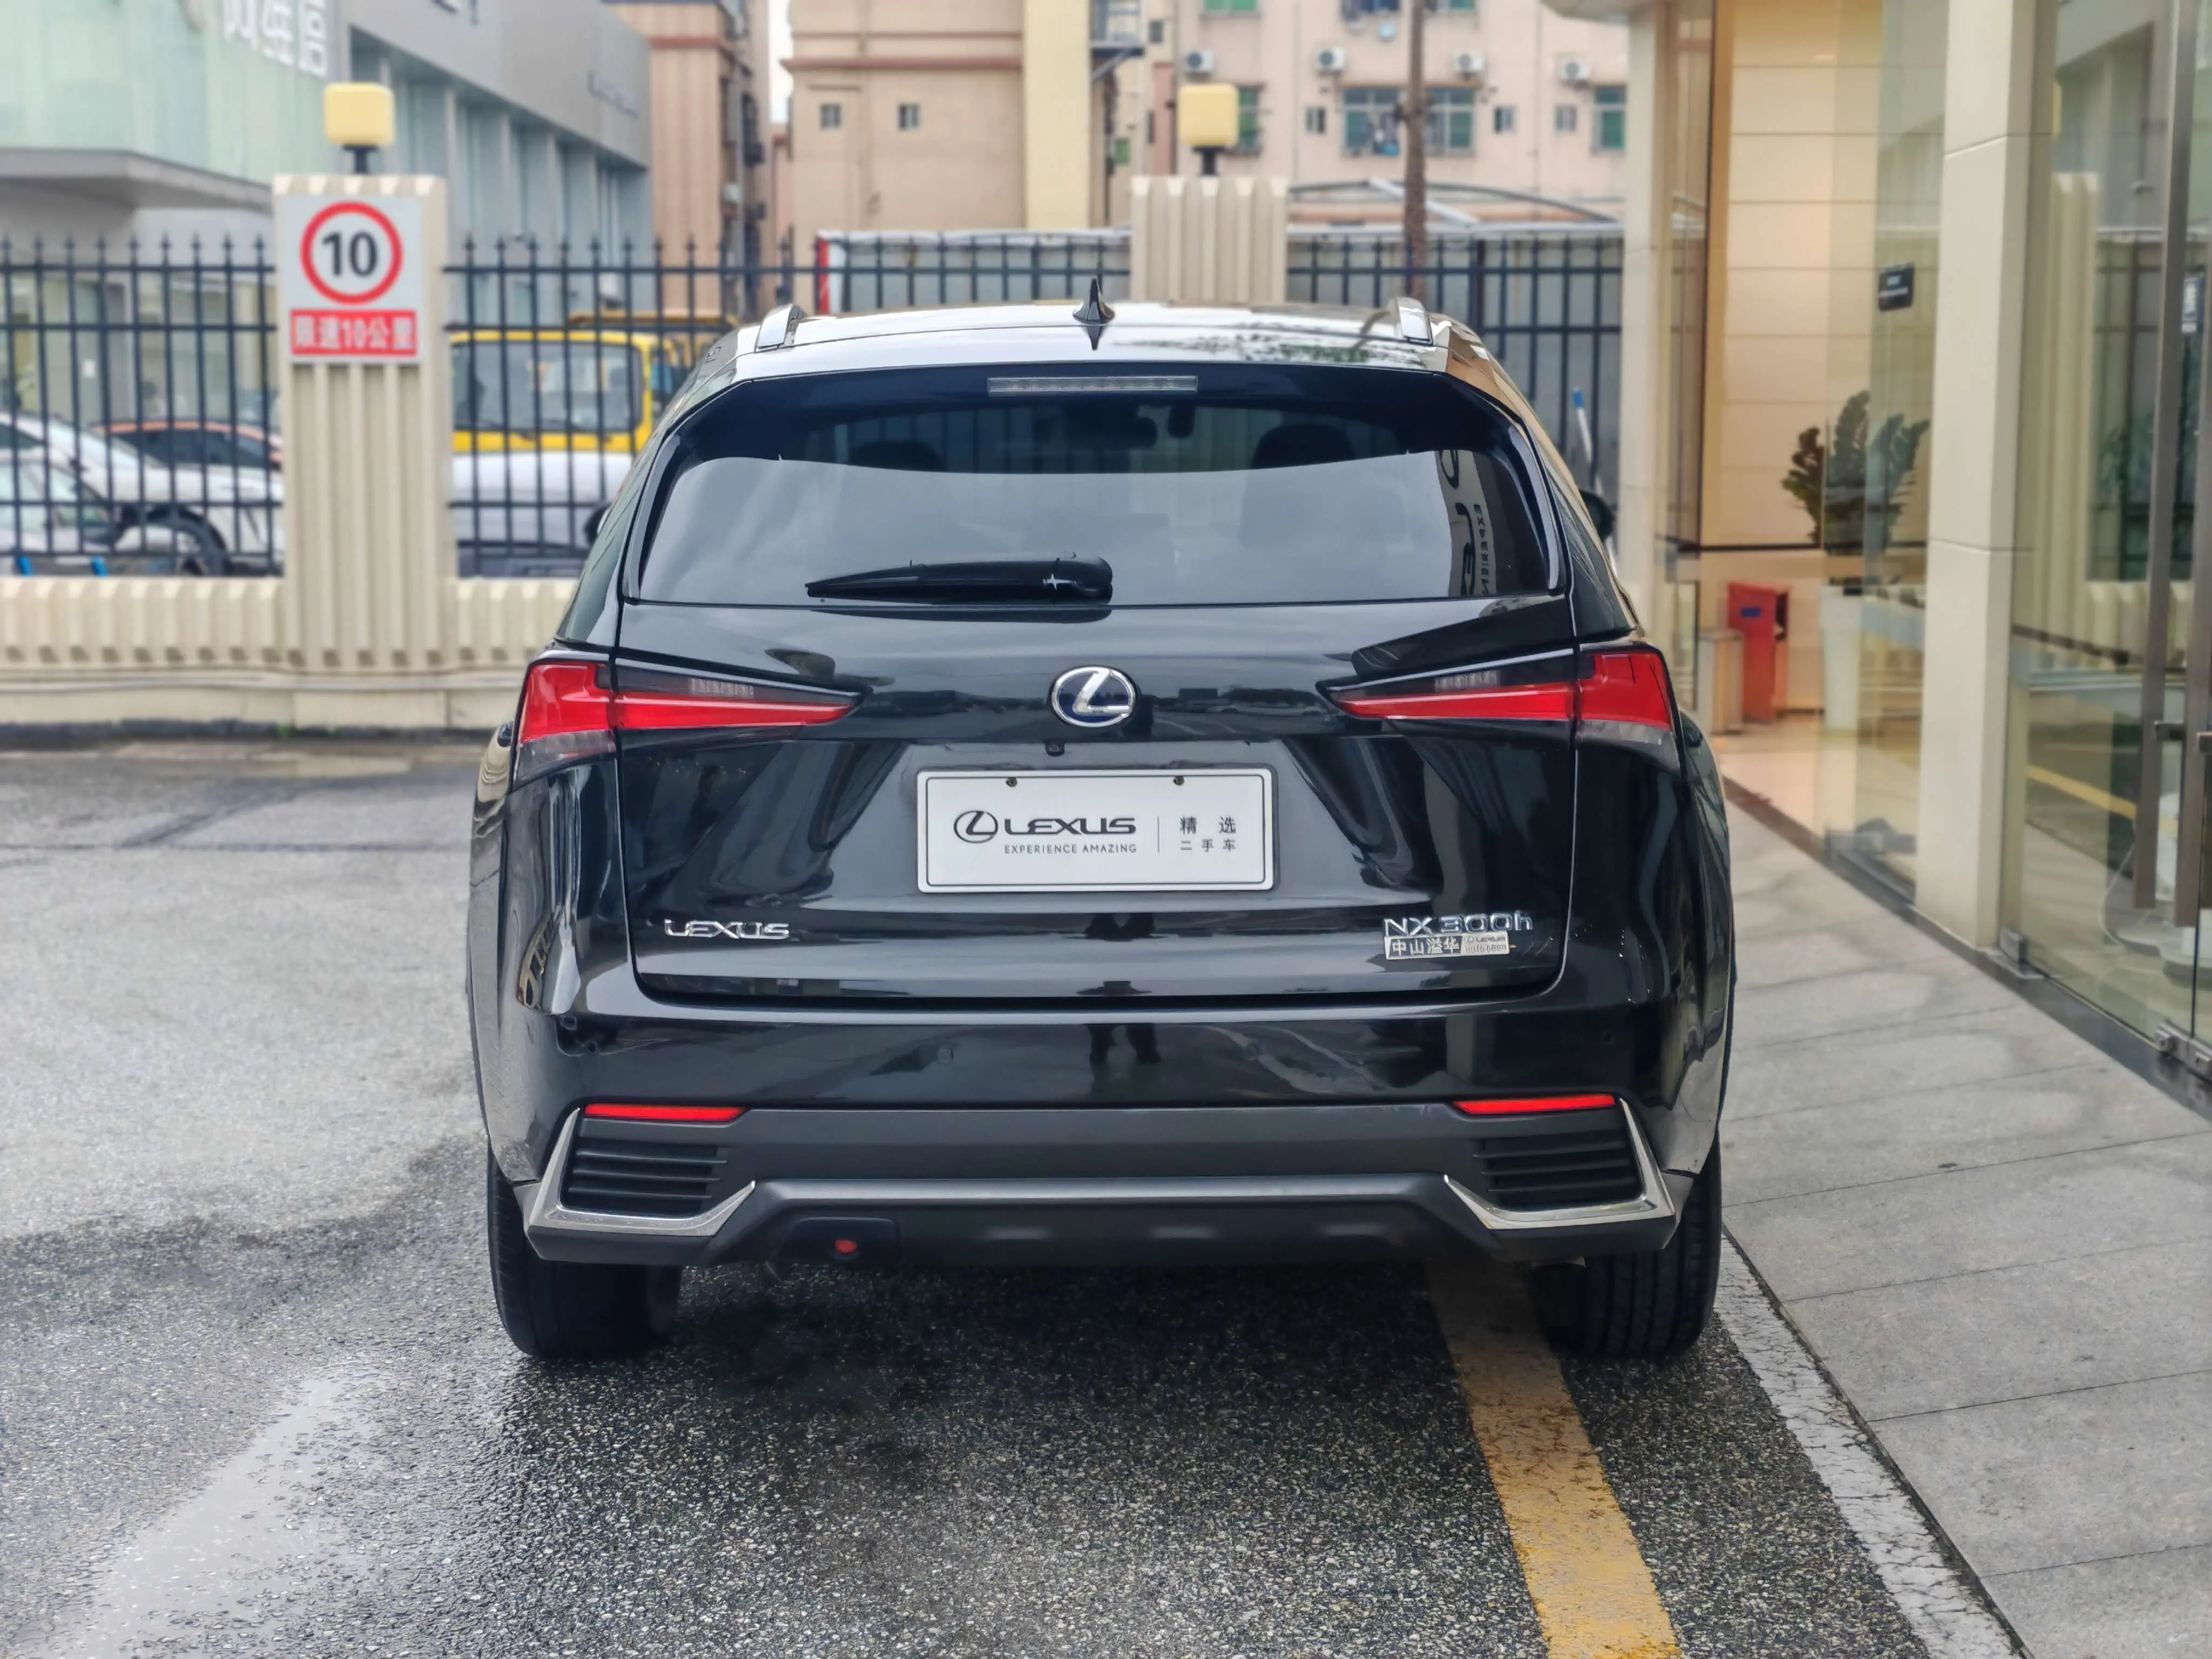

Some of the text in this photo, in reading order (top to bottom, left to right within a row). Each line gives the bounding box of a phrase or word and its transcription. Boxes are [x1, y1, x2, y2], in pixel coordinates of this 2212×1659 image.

[322, 231, 379, 277] 10
[1004, 818, 1137, 835] LEXUS
[1004, 843, 1137, 854] EXPERIENCE AMAZING
[664, 919, 790, 940] LEXUS
[1383, 910, 1533, 938] NX 300h
